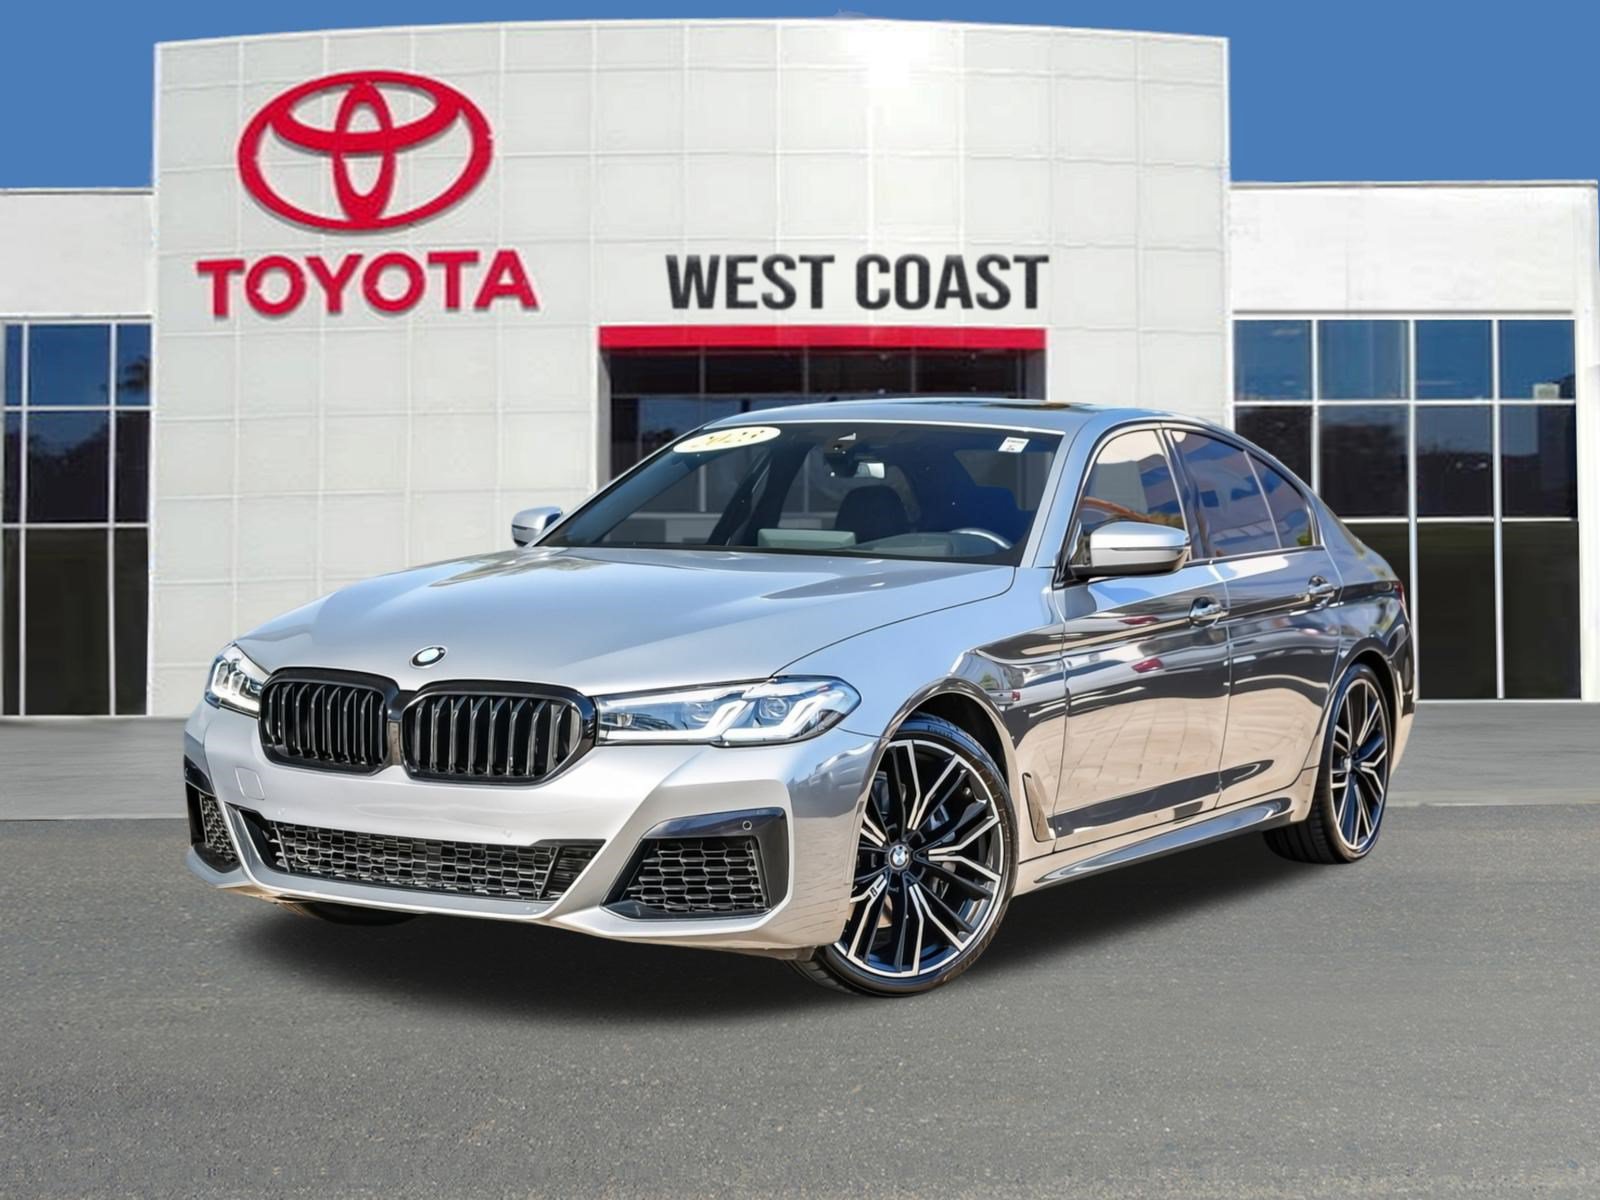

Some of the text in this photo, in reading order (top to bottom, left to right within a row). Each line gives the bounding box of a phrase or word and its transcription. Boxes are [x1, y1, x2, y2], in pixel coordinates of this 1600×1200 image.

[196, 250, 539, 317] TOYOTA
[665, 254, 1050, 310] WEST COAST
